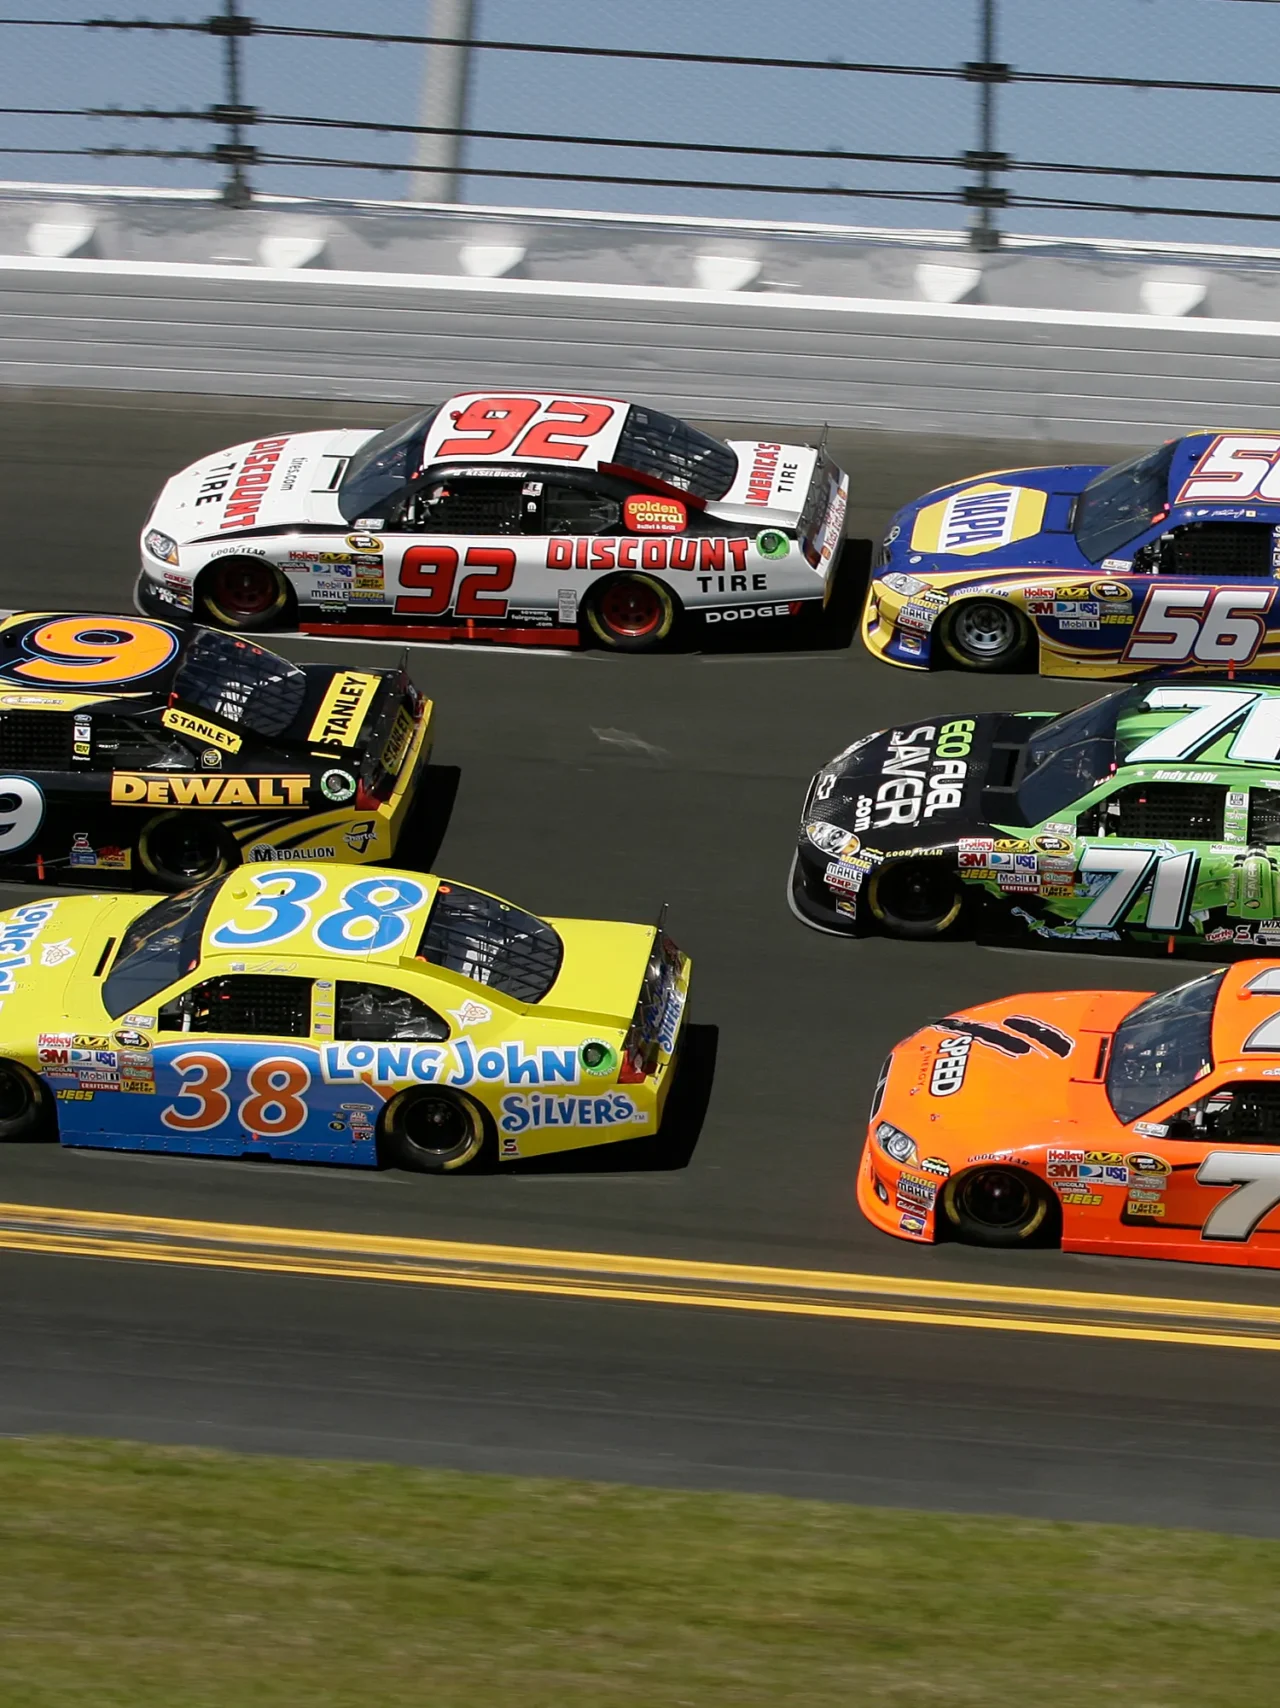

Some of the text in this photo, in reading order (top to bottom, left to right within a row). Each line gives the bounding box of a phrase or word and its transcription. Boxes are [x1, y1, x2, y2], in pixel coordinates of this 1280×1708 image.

[435, 398, 614, 461] 92
[280, 457, 308, 491] tires.com
[466, 470, 527, 478] KESELOWSKI
[778, 462, 798, 493] TIRE
[196, 463, 238, 507] TIRE
[220, 438, 290, 529] DISCOUNT
[628, 501, 678, 514] golden
[636, 512, 683, 523] corral
[945, 492, 1011, 547] NAPA
[289, 551, 319, 562] Holley
[546, 537, 748, 571] DISCOUNT
[334, 565, 352, 577] USG
[393, 545, 515, 618] 92
[697, 574, 767, 592] TIRE
[311, 591, 348, 599] MAHLE
[1024, 589, 1054, 598] Holley
[705, 604, 790, 623] DODGE
[901, 607, 933, 622] MAHLE
[1028, 603, 1052, 614] 3M
[1080, 603, 1097, 615] USG
[1061, 620, 1086, 628] Mobil
[1101, 615, 1134, 624] JEGS
[1121, 584, 1278, 667] 56
[10, 614, 177, 686] 9
[323, 676, 367, 746] STANLEY
[169, 713, 237, 746] STANLEY
[936, 719, 975, 758] ECO
[872, 726, 936, 830] SAVER
[1153, 769, 1217, 782] Andy Lally
[924, 760, 967, 818] FUEL
[854, 795, 873, 832] .com
[254, 848, 335, 863] MEDALLION
[885, 849, 943, 858] GOODYEAR
[960, 854, 986, 867] 3M
[841, 855, 872, 869] MOOG
[1016, 855, 1035, 869] USG
[827, 863, 862, 880] MAHLE
[961, 870, 998, 879] JEGS
[826, 875, 852, 887] COMP
[1076, 846, 1198, 930] 71
[211, 869, 428, 954] 38
[39, 1034, 71, 1047] Holley
[40, 1049, 68, 1064] 3M
[96, 1052, 116, 1067] USG
[321, 1044, 444, 1083] LONG
[918, 1050, 932, 1086] ENERGY
[929, 1033, 975, 1097] SPEED
[81, 1072, 108, 1080] Mobil
[57, 1090, 94, 1100] JEGS
[161, 1052, 311, 1136] 38
[967, 1153, 1030, 1168] GOODYEAR
[1048, 1150, 1083, 1163] Holley
[1048, 1164, 1077, 1178] 3M
[1105, 1167, 1127, 1182] USG
[901, 1172, 936, 1188] MOOG
[898, 1181, 934, 1200] MAHLE
[1062, 1194, 1102, 1205] JEGS
